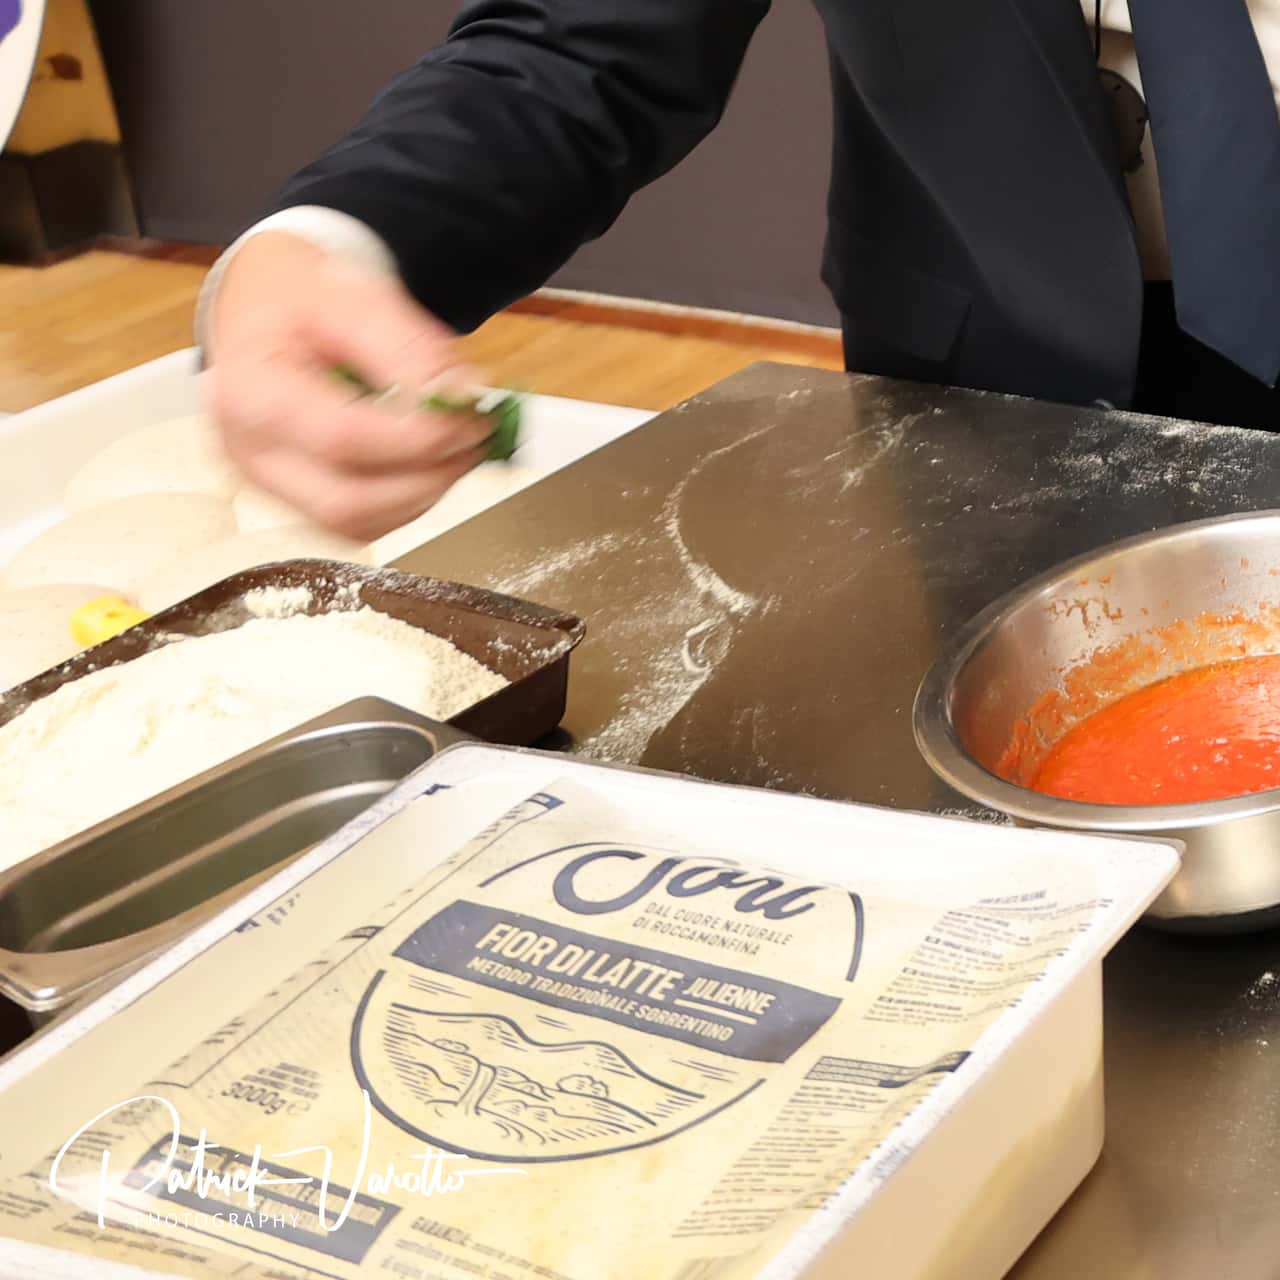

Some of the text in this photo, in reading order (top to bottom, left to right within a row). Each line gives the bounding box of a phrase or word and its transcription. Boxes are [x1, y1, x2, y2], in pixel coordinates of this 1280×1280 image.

[632, 916, 761, 956] DI ROCCAMONFINA
[644, 902, 793, 946] DAL CUORE NATURALE
[465, 956, 734, 1041] METODO TRADIZIONALE SORRENTINO
[475, 922, 777, 1015] FIOR DI LATTE JULIENNE
